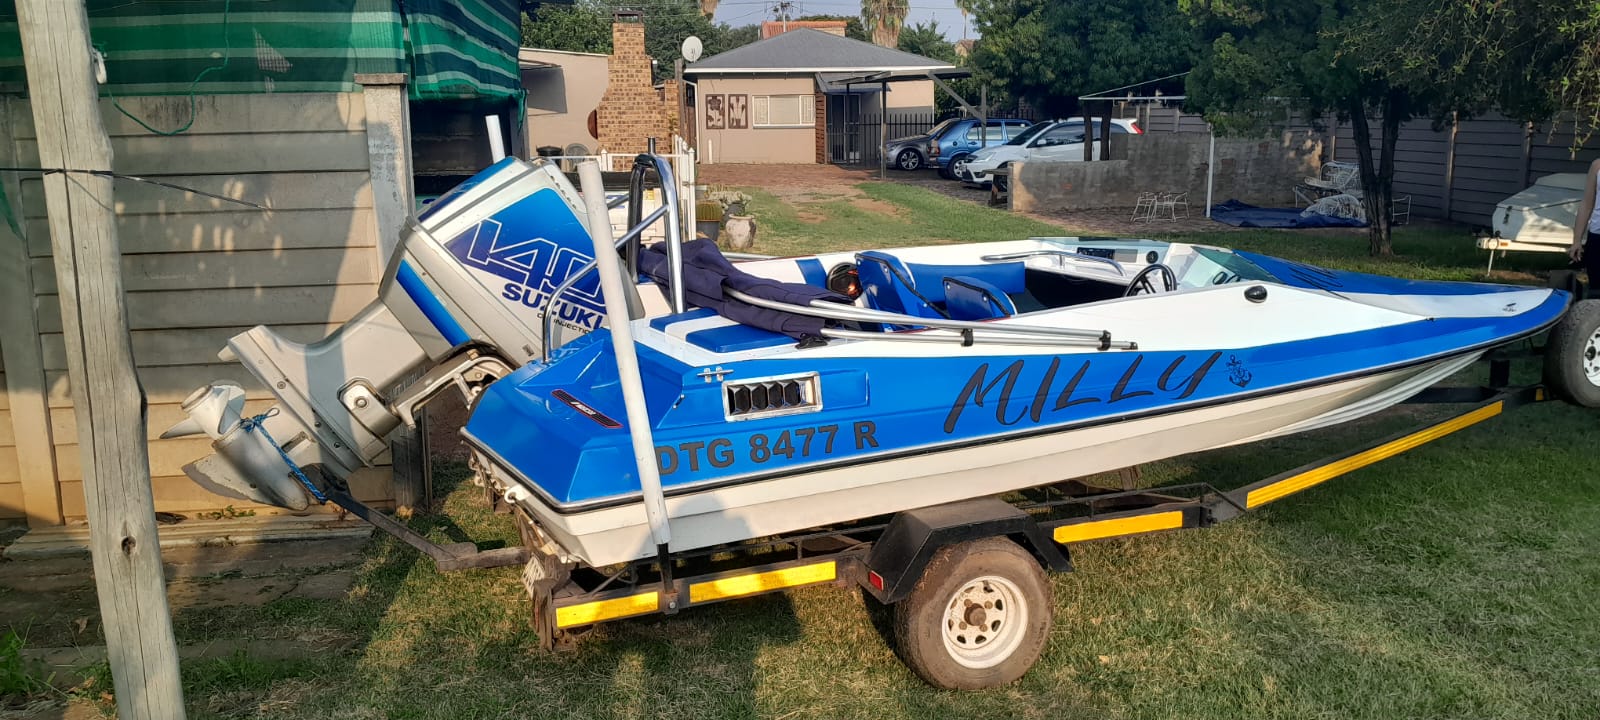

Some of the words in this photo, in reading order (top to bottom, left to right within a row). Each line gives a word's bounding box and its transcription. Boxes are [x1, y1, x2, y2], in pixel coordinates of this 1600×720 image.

[467, 218, 606, 306] 140
[656, 438, 735, 476] DTG
[749, 424, 838, 464] 8477
[853, 420, 879, 450] R
